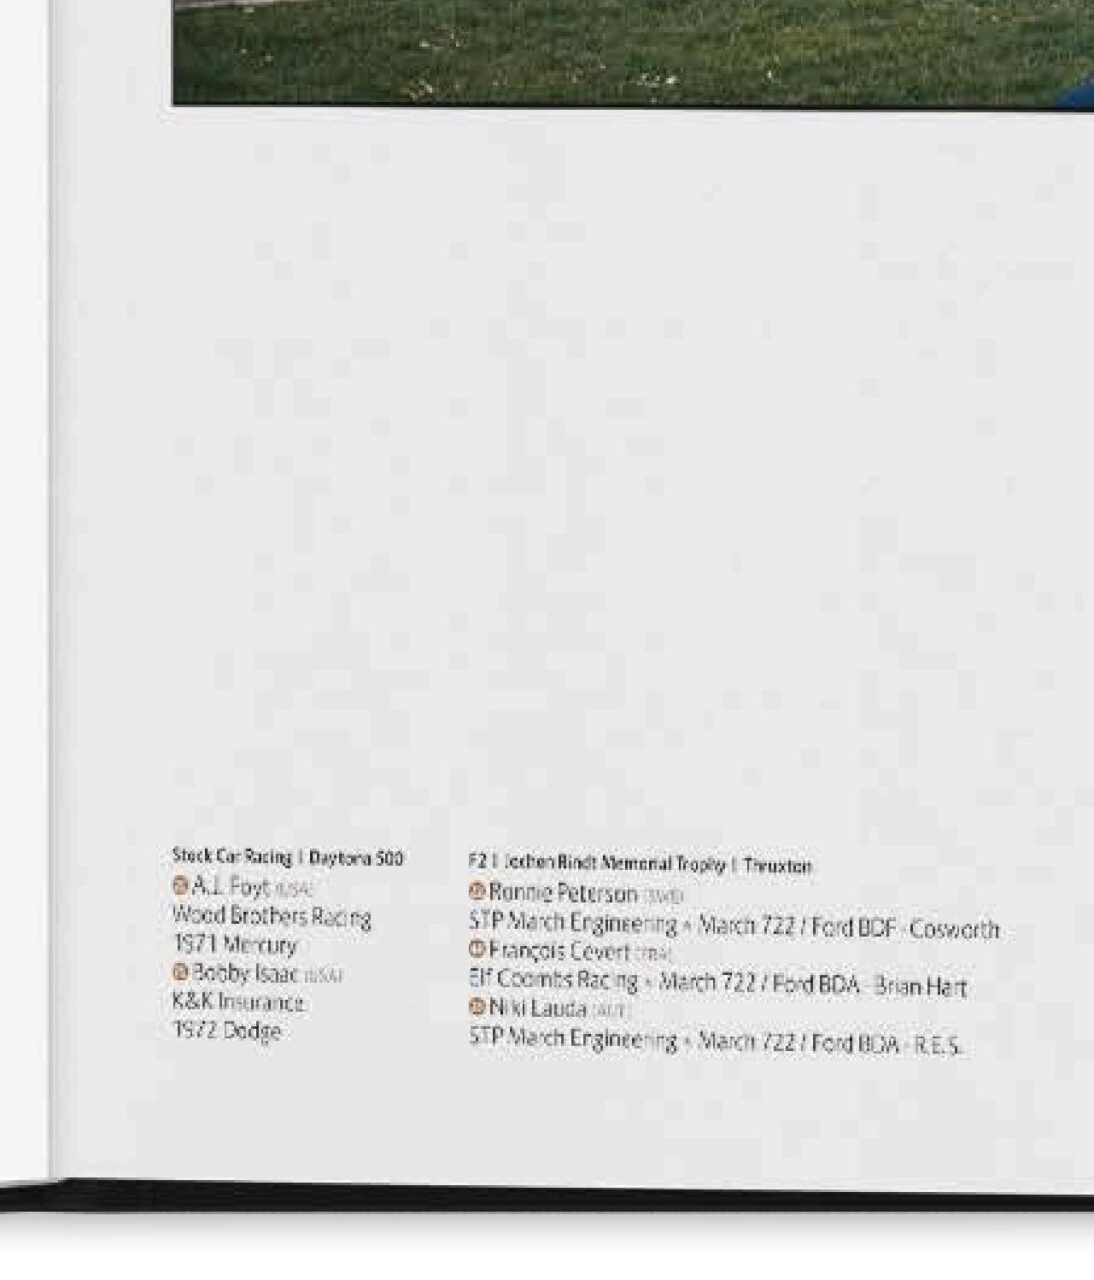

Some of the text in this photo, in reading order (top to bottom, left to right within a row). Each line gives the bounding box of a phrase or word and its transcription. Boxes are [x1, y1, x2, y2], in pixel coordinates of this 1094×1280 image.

[173, 847, 212, 863] Stock
[216, 848, 241, 863] Car
[245, 848, 292, 868] Racing
[309, 850, 371, 868] Daytona
[376, 851, 404, 866] 500
[468, 853, 487, 869] F2
[602, 854, 672, 871] Memorial
[676, 855, 726, 875] Trophy
[230, 876, 271, 900] Foyt
[489, 882, 552, 903] Ronnie
[558, 882, 638, 903] Peterson
[173, 904, 372, 932] Wood Brothers Racing
[469, 909, 503, 930] STP
[508, 911, 564, 932] March
[571, 911, 678, 938] Engineering
[699, 914, 755, 935] March
[812, 916, 853, 937] Ford
[910, 918, 1001, 939] Cosworth
[224, 935, 297, 958] Mercury
[489, 940, 565, 963] François
[571, 941, 630, 961] Cevert
[192, 963, 249, 986] Bobby
[255, 964, 298, 983] Isaac
[497, 969, 572, 988] Coombs
[578, 970, 638, 995] Racing
[659, 972, 716, 992] March
[773, 974, 814, 993] Ford
[875, 975, 922, 996] Brian
[927, 976, 968, 997] Hart
[172, 991, 306, 1012] K&K Insurance
[489, 997, 526, 1016] Niki
[531, 999, 587, 1018] Lauda
[224, 1021, 282, 1046] Dodge
[469, 1026, 503, 1045] STP
[509, 1026, 564, 1047] March
[571, 1028, 678, 1055] Engineering
[699, 1031, 755, 1052] March
[812, 1033, 853, 1053] Ford
